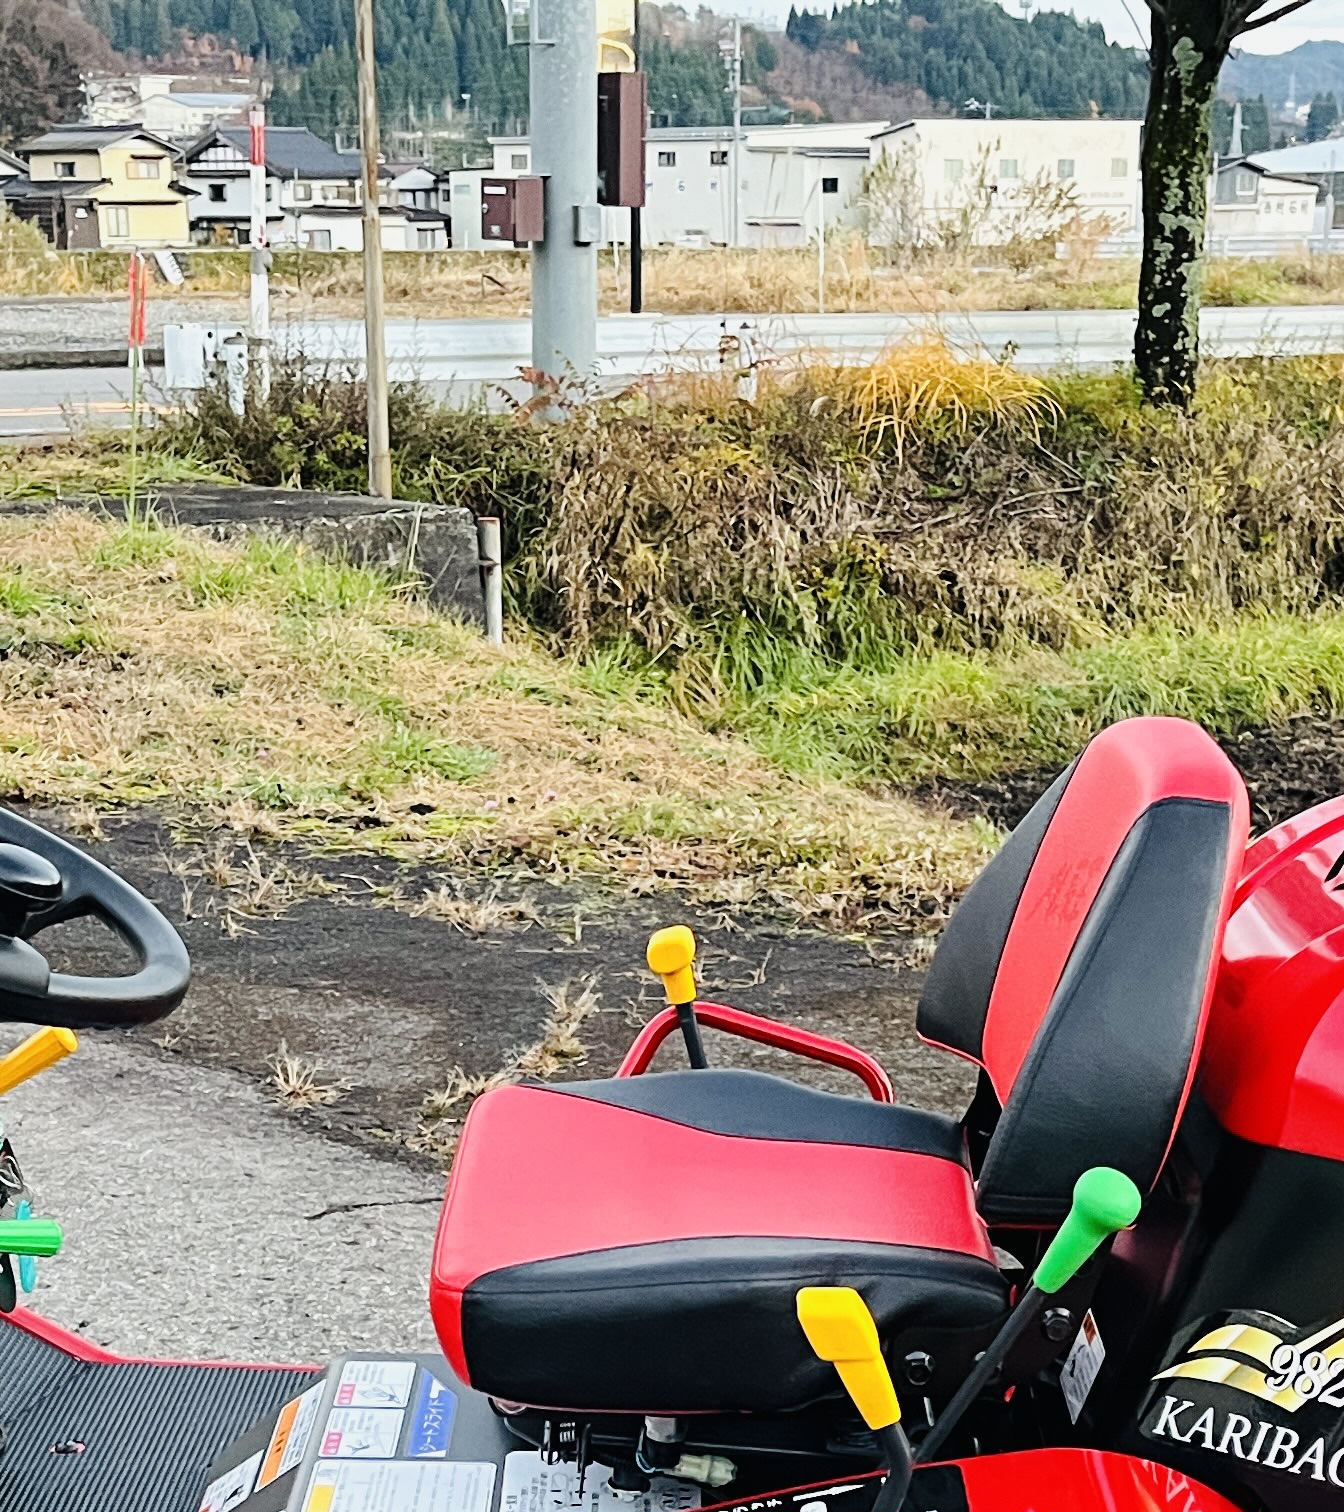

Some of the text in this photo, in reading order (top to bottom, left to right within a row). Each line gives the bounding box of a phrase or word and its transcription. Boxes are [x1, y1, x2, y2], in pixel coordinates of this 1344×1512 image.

[418, 1400, 445, 1452] シートスライド
